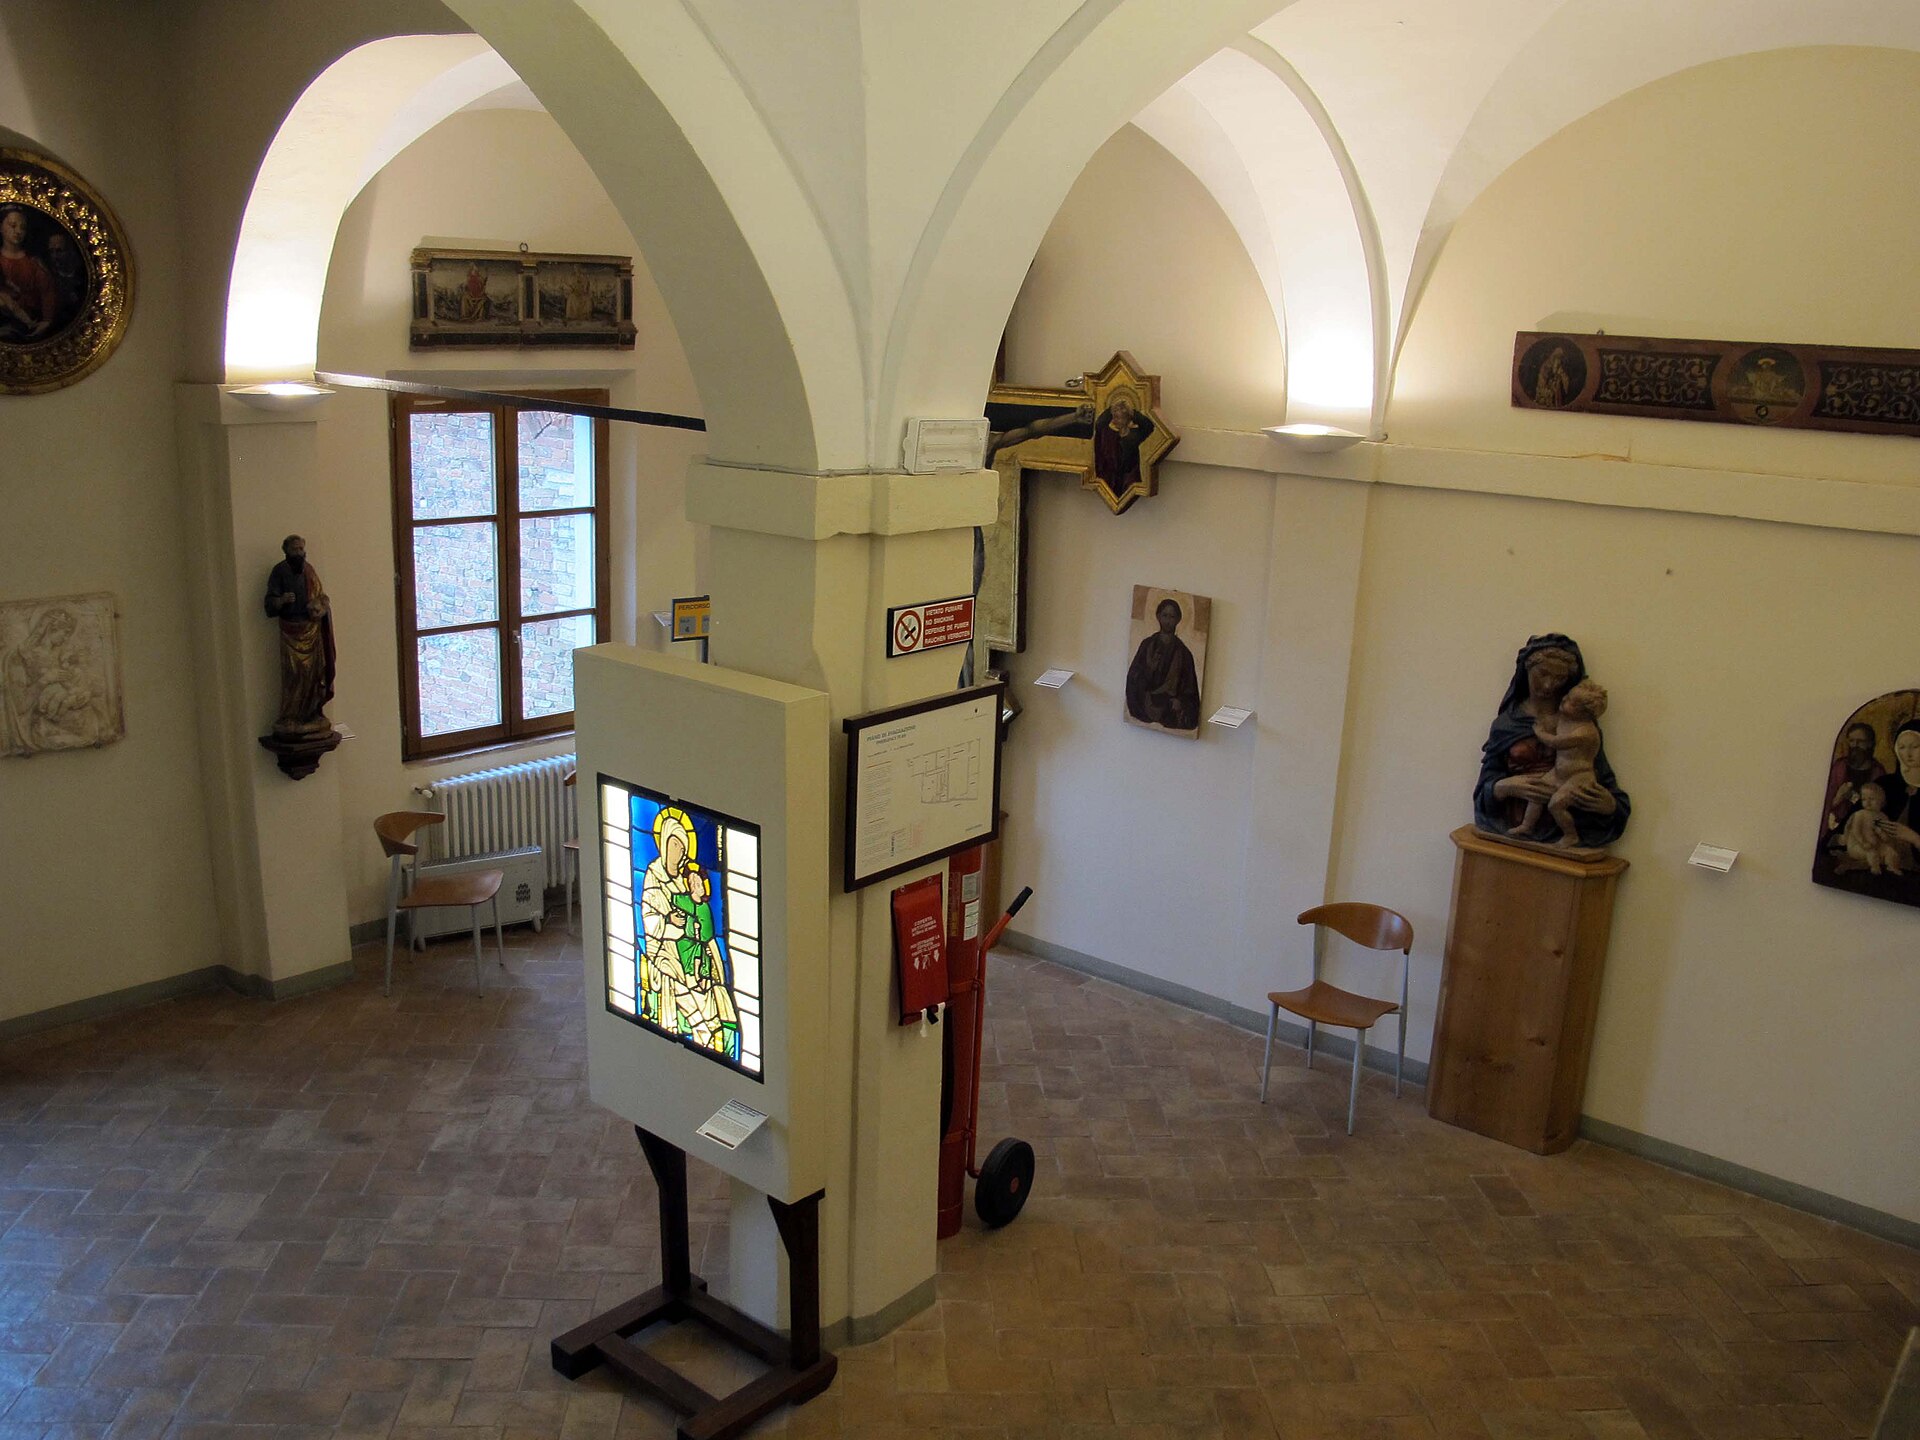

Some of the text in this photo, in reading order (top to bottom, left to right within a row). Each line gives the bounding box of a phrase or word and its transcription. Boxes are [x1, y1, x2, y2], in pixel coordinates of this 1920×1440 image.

[926, 604, 963, 616] VIETATO FUMARE
[933, 615, 955, 625] SMOKING
[925, 626, 946, 635] DEFENSE
[953, 621, 970, 629] FUMER
[924, 630, 970, 645] RAUCHEN VERBOTEN
